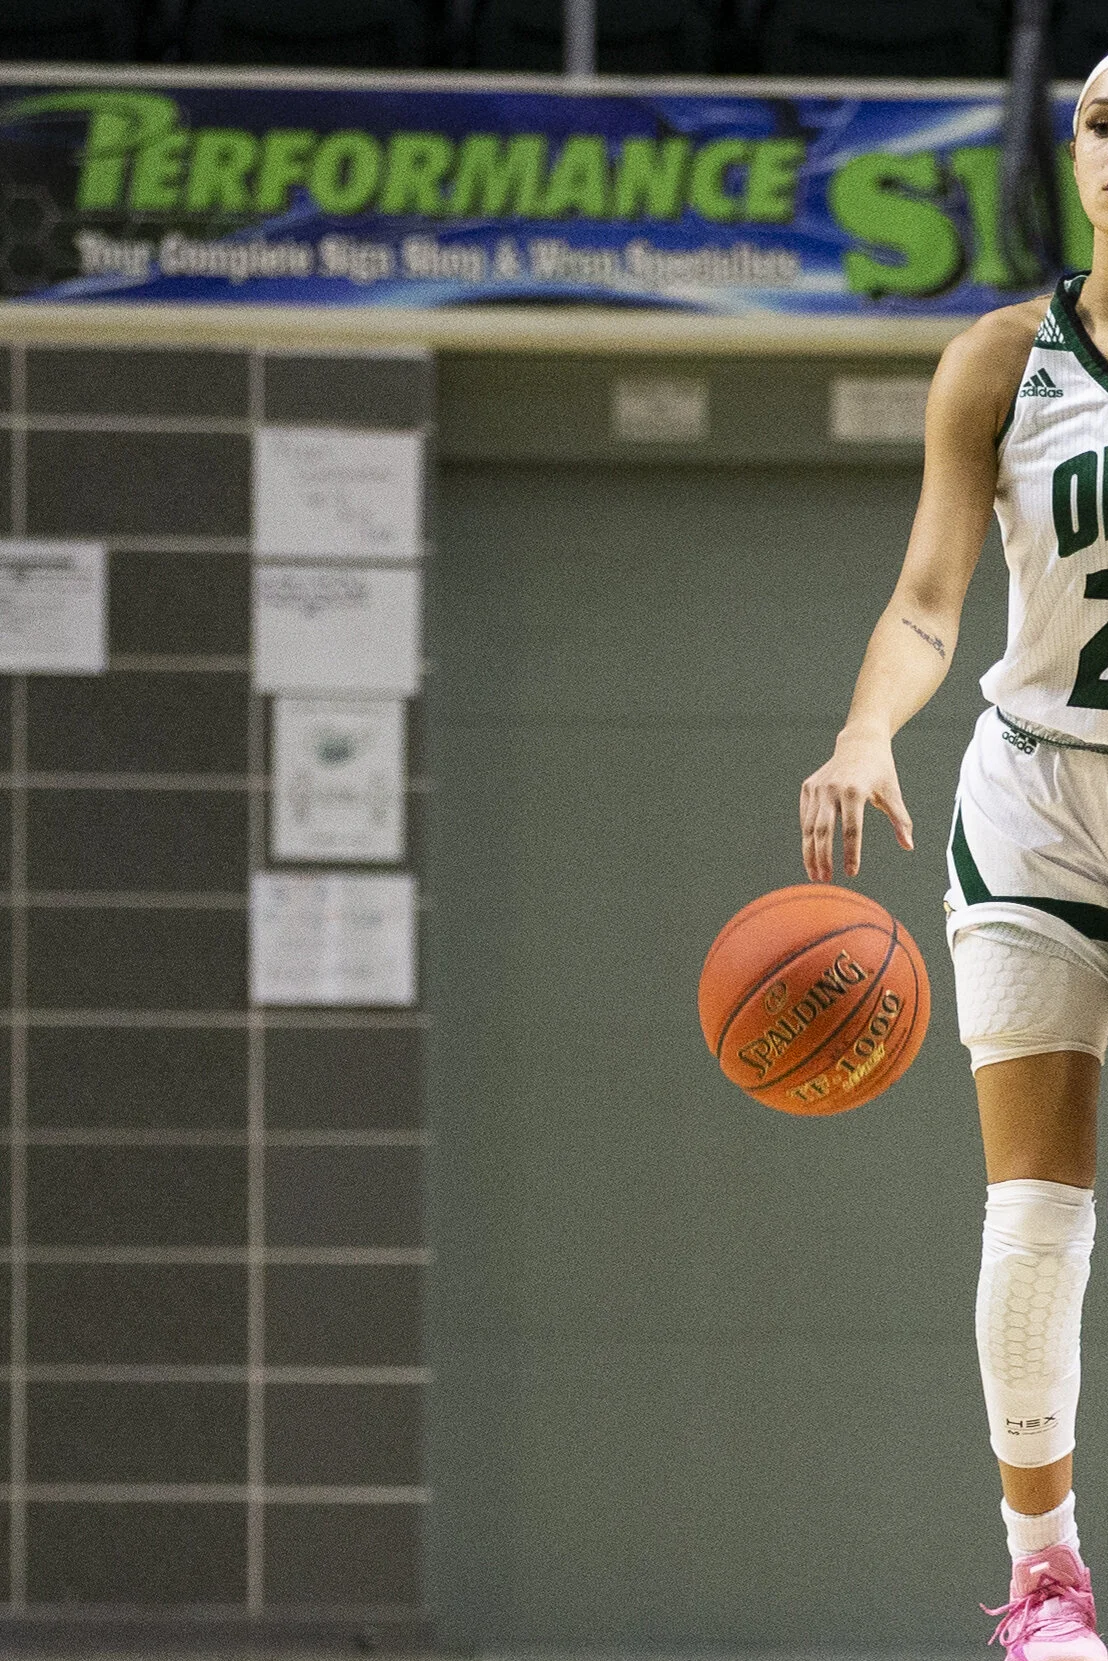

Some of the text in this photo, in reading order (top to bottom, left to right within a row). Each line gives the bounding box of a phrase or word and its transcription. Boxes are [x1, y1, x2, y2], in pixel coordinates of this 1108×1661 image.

[22, 91, 800, 221] PERFORMANCE
[1019, 386, 1064, 398] adidas
[1002, 731, 1034, 755] adida
[737, 950, 868, 1079] SPALDING
